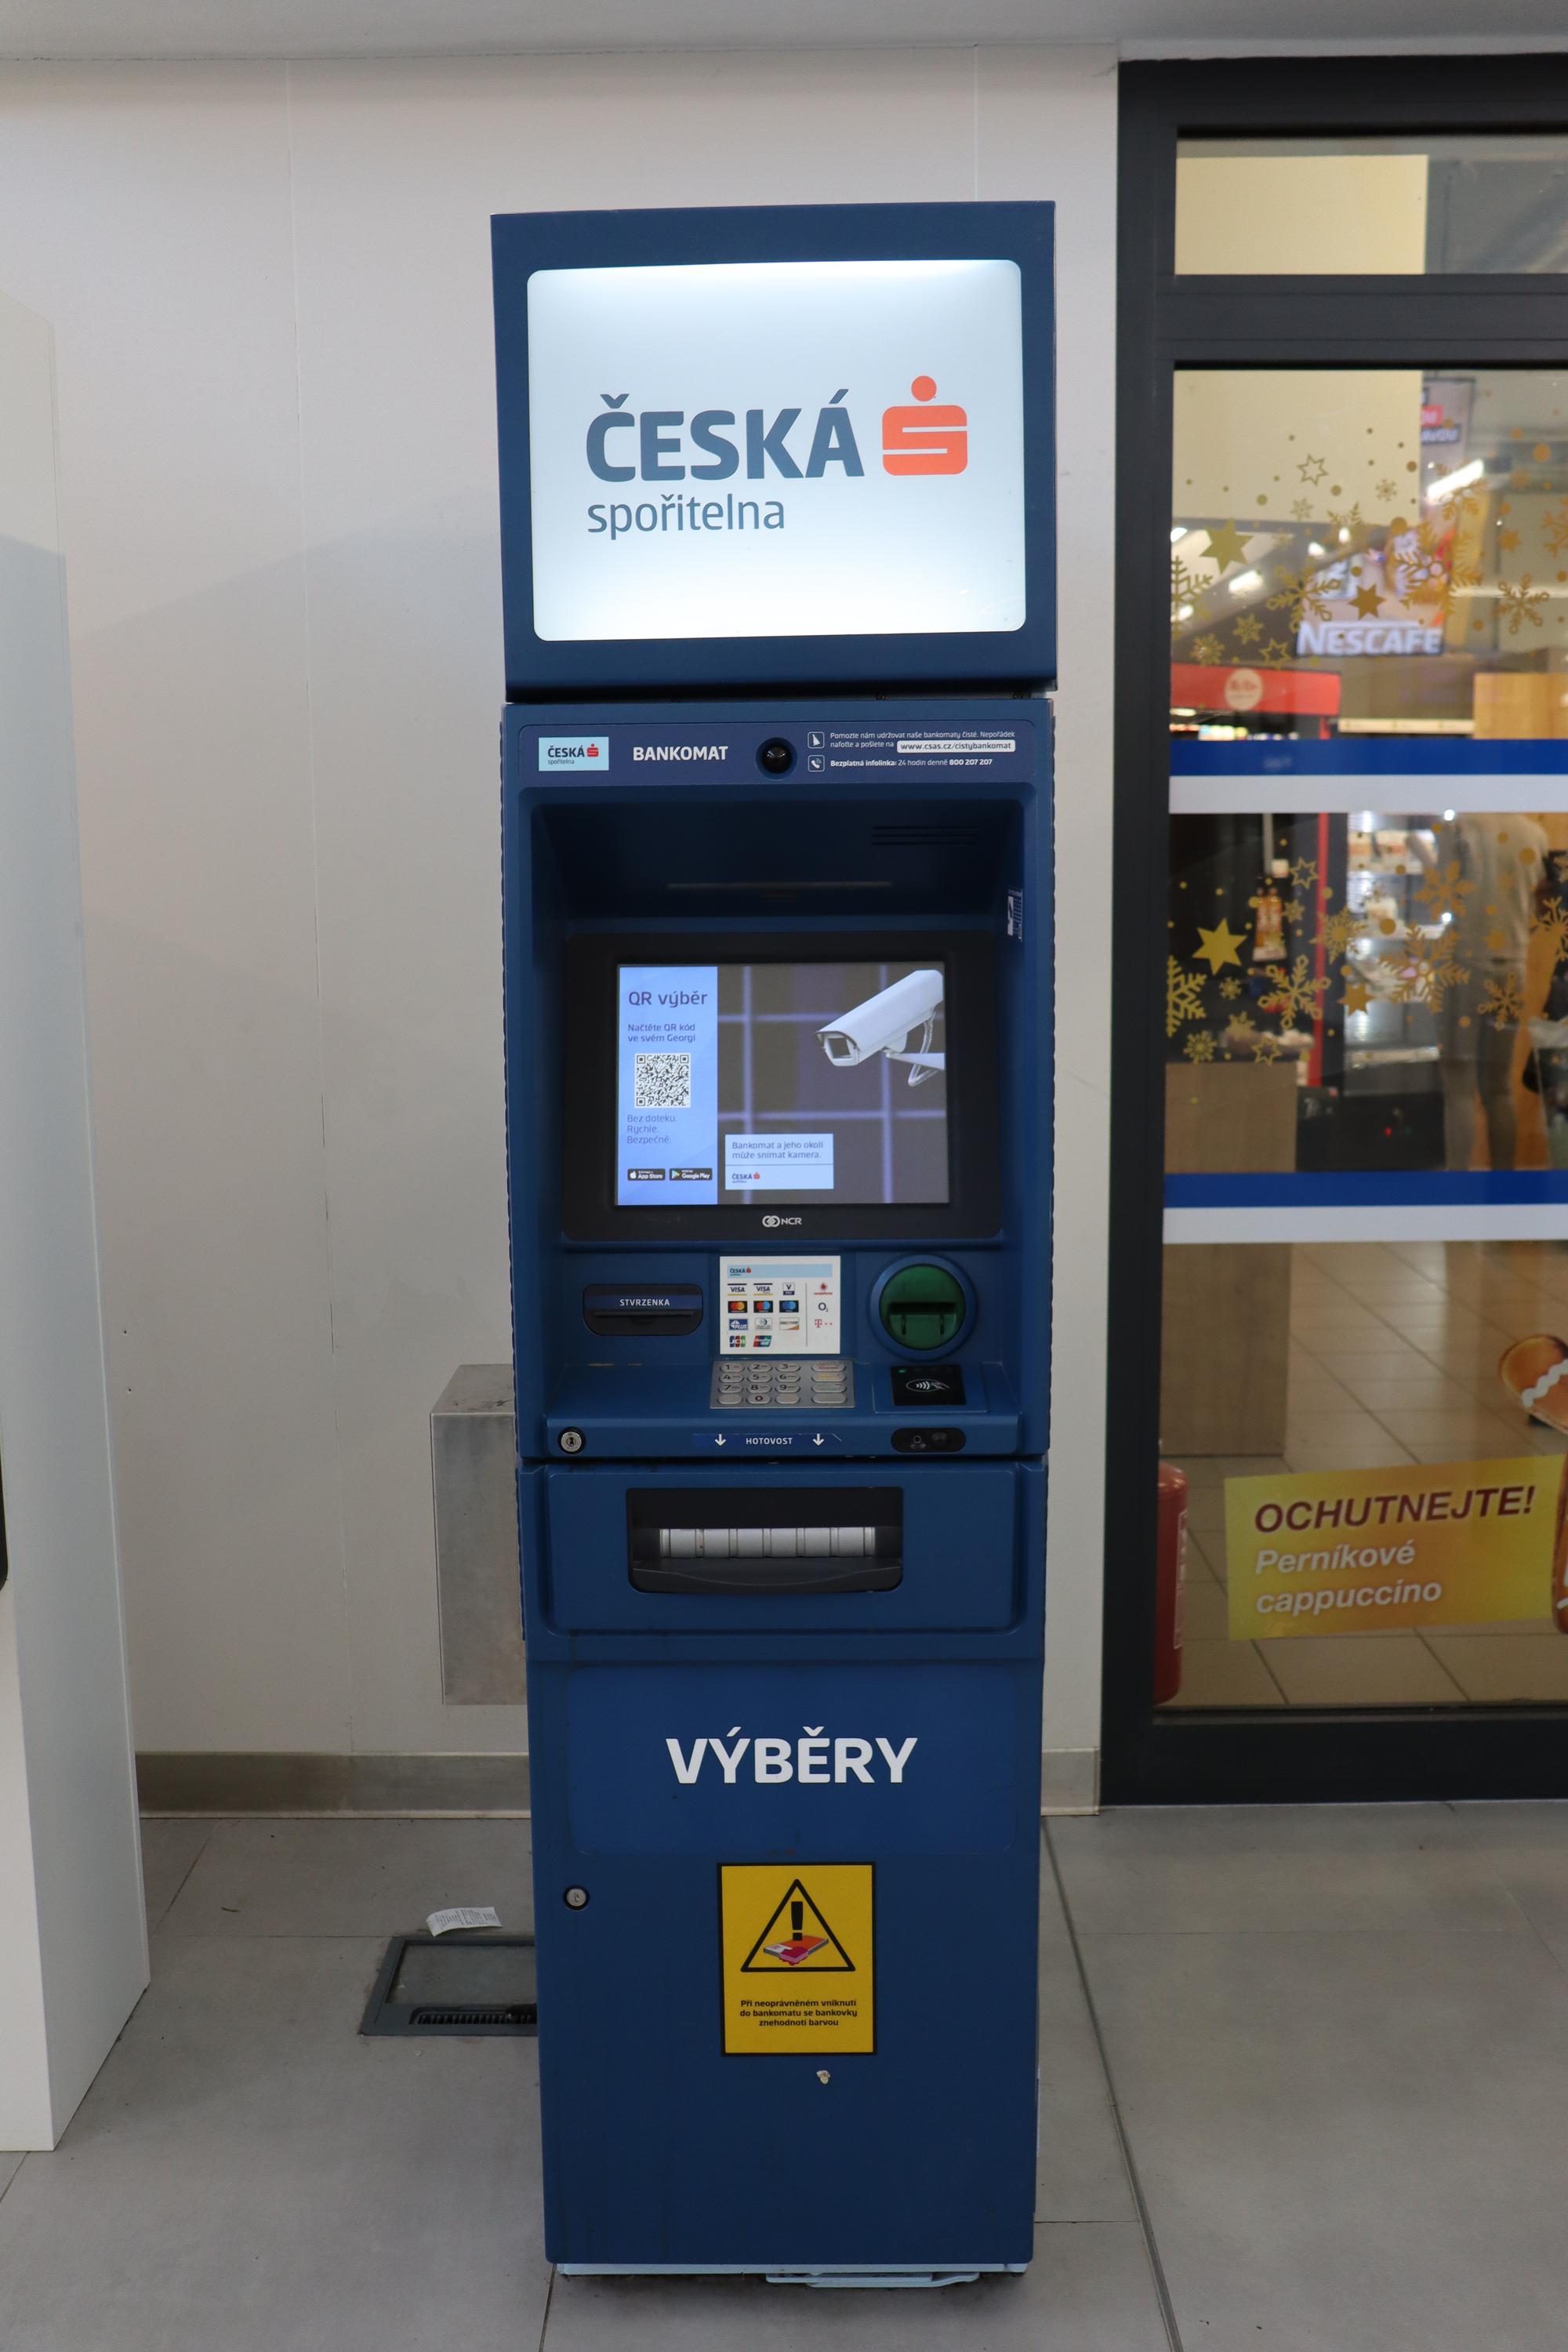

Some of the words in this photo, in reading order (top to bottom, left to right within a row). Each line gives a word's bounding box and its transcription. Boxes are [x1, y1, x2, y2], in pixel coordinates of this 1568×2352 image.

[586, 388, 865, 483] ČESKÁ
[587, 493, 784, 541] spořitelna
[548, 745, 585, 758] ČESKÁ
[901, 742, 1011, 750] www.csas.cz/cistybankomat
[633, 746, 728, 761] BANKOMAT
[830, 759, 864, 768] Bezplatná
[866, 758, 897, 767] infolinka:
[927, 758, 948, 767] denně
[628, 991, 652, 1006] QR
[658, 990, 708, 1008] výběr
[628, 1023, 662, 1032] Načtěte
[663, 1023, 677, 1032] QR
[679, 1023, 695, 1032] kód
[627, 1114, 643, 1123] Bez
[644, 1114, 678, 1123] doteku.
[627, 1125, 659, 1134] Rychle.
[627, 1135, 672, 1145] Bezpečně.
[783, 1142, 801, 1150] jeho
[781, 1217, 802, 1225] NCR
[1255, 1485, 1536, 1534] OCHUTNEJTE!
[1255, 1539, 1416, 1574] Perníkové
[1256, 1579, 1443, 1617] cappuccino
[666, 1726, 918, 1784] VÝBĚRY
